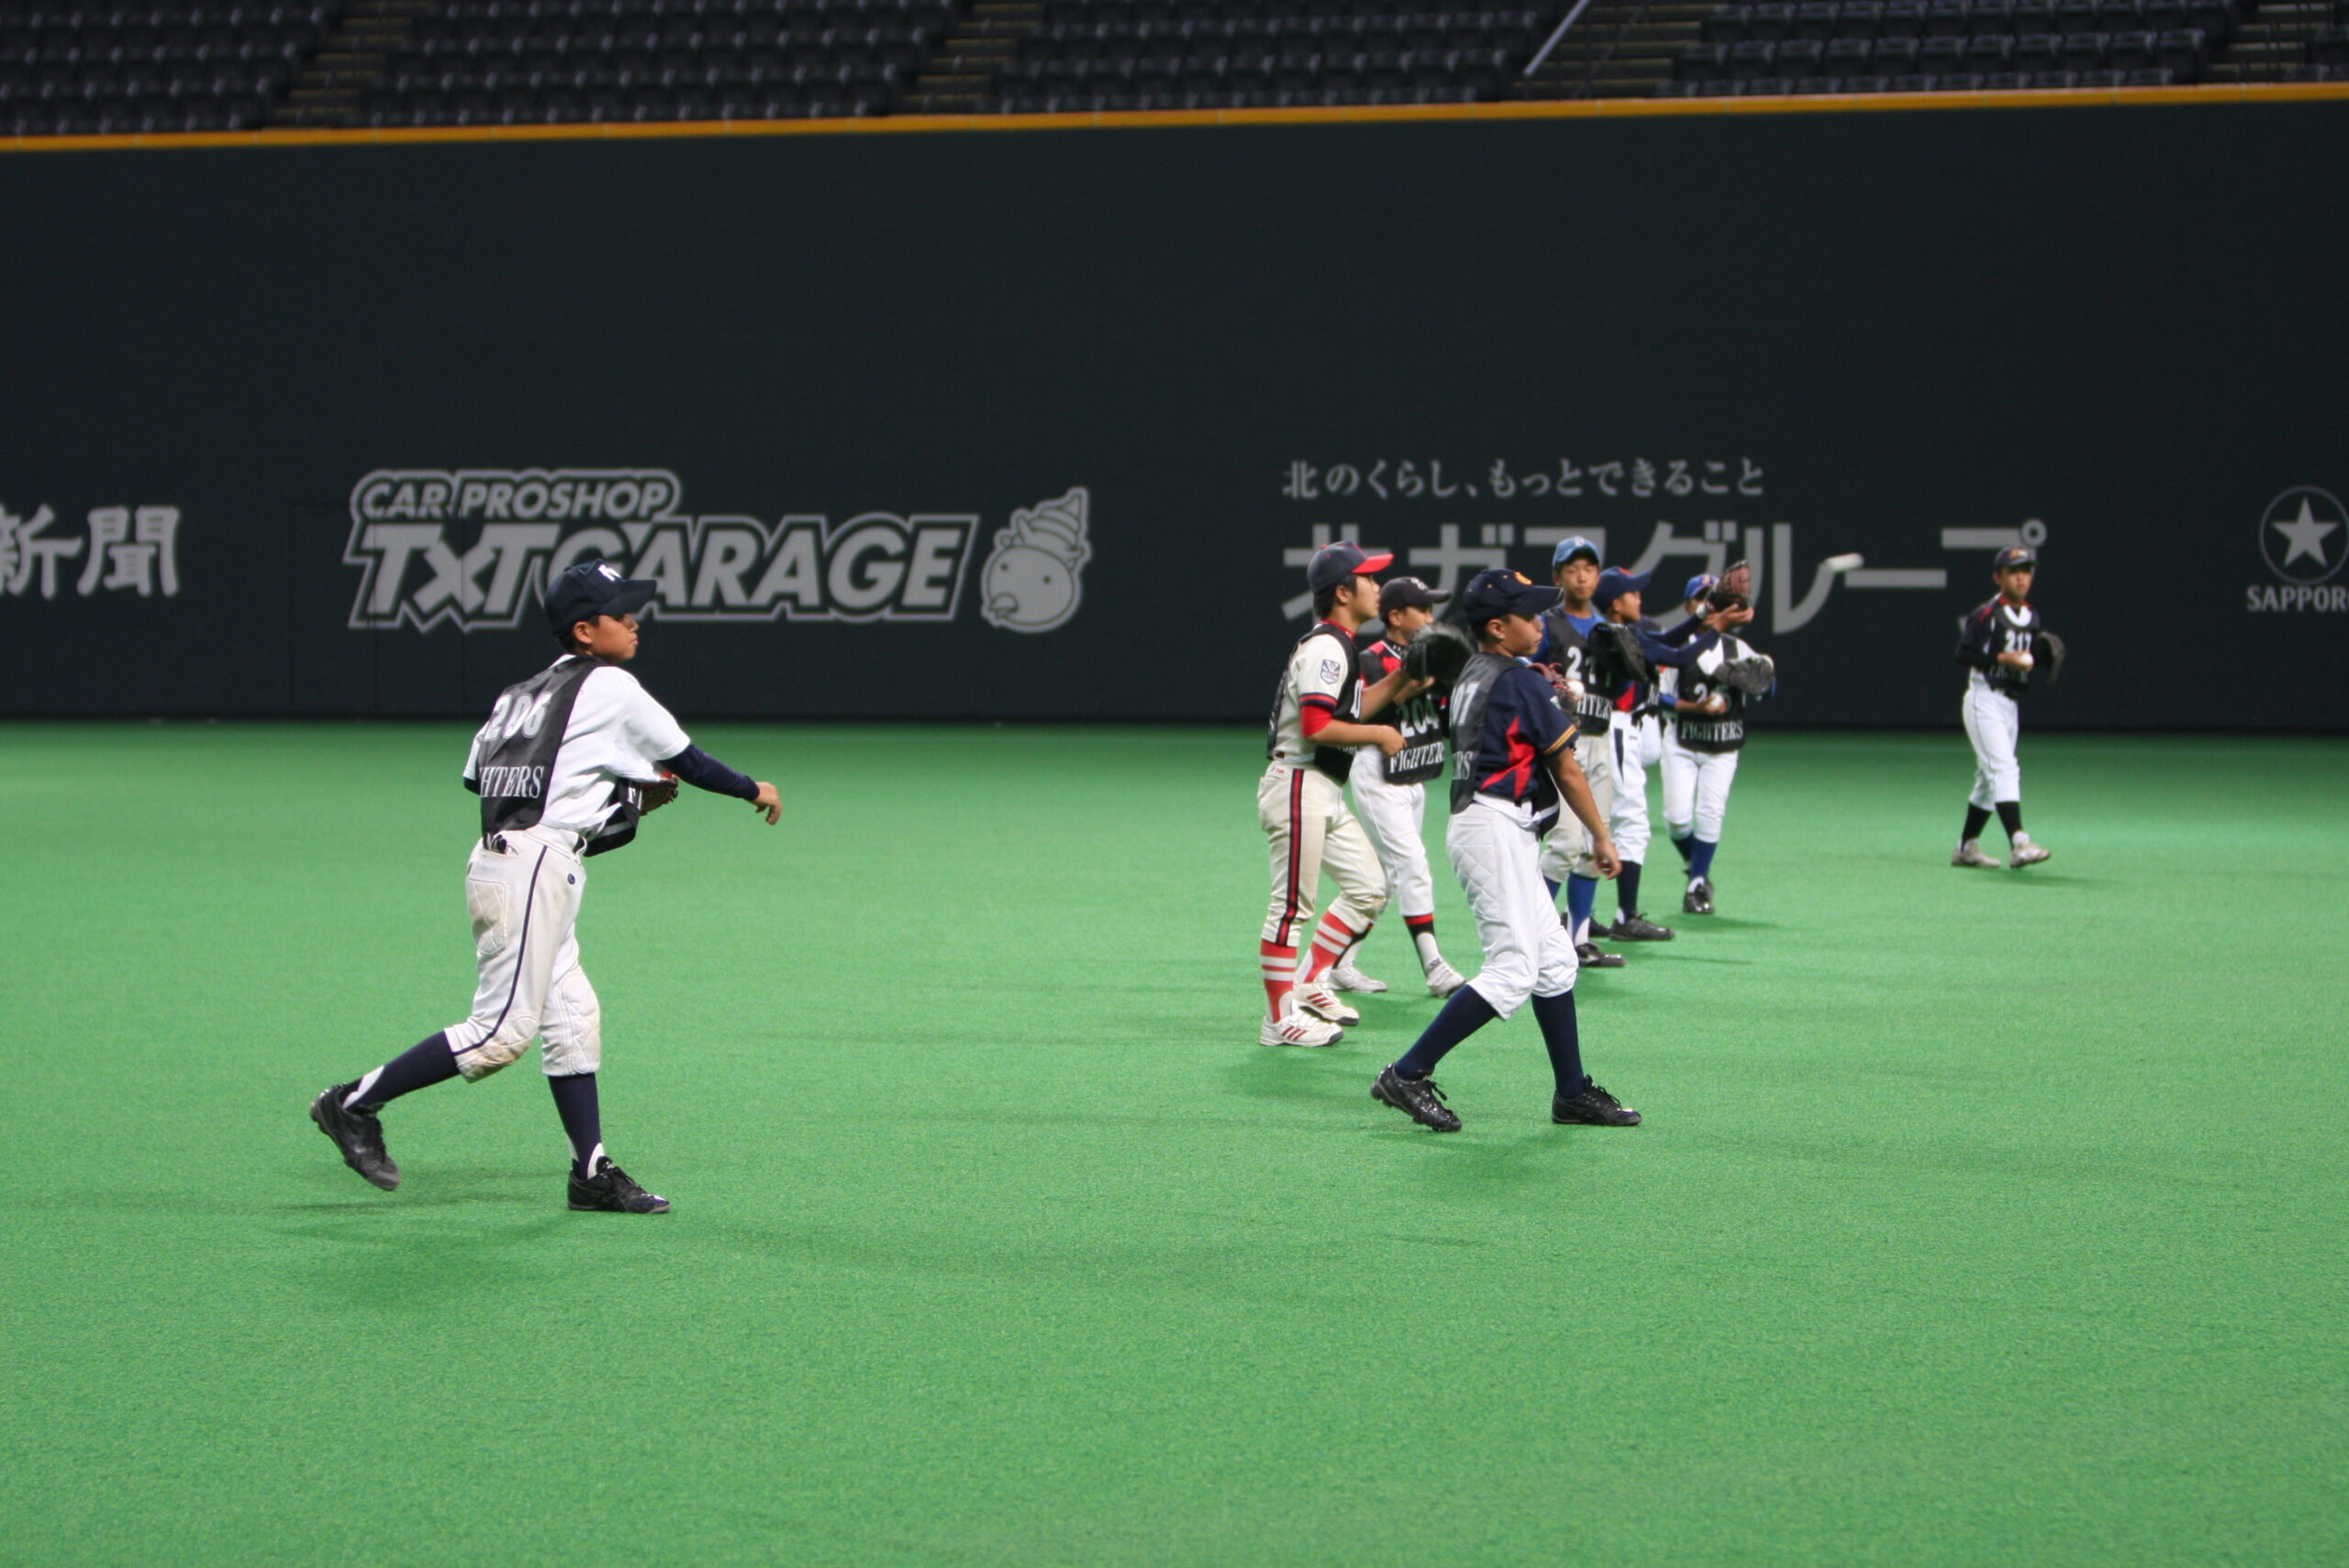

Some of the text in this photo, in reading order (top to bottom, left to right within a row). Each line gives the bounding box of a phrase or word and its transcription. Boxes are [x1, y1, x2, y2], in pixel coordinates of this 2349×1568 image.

[1282, 460, 1765, 499] 北のくらし、もっとできること
[362, 481, 669, 519] CAR PROSHOP
[2246, 584, 2349, 612] SAPPOR
[1396, 694, 1440, 738] 204
[1388, 740, 1446, 773] FIGHTER
[479, 765, 544, 799] HTERS
